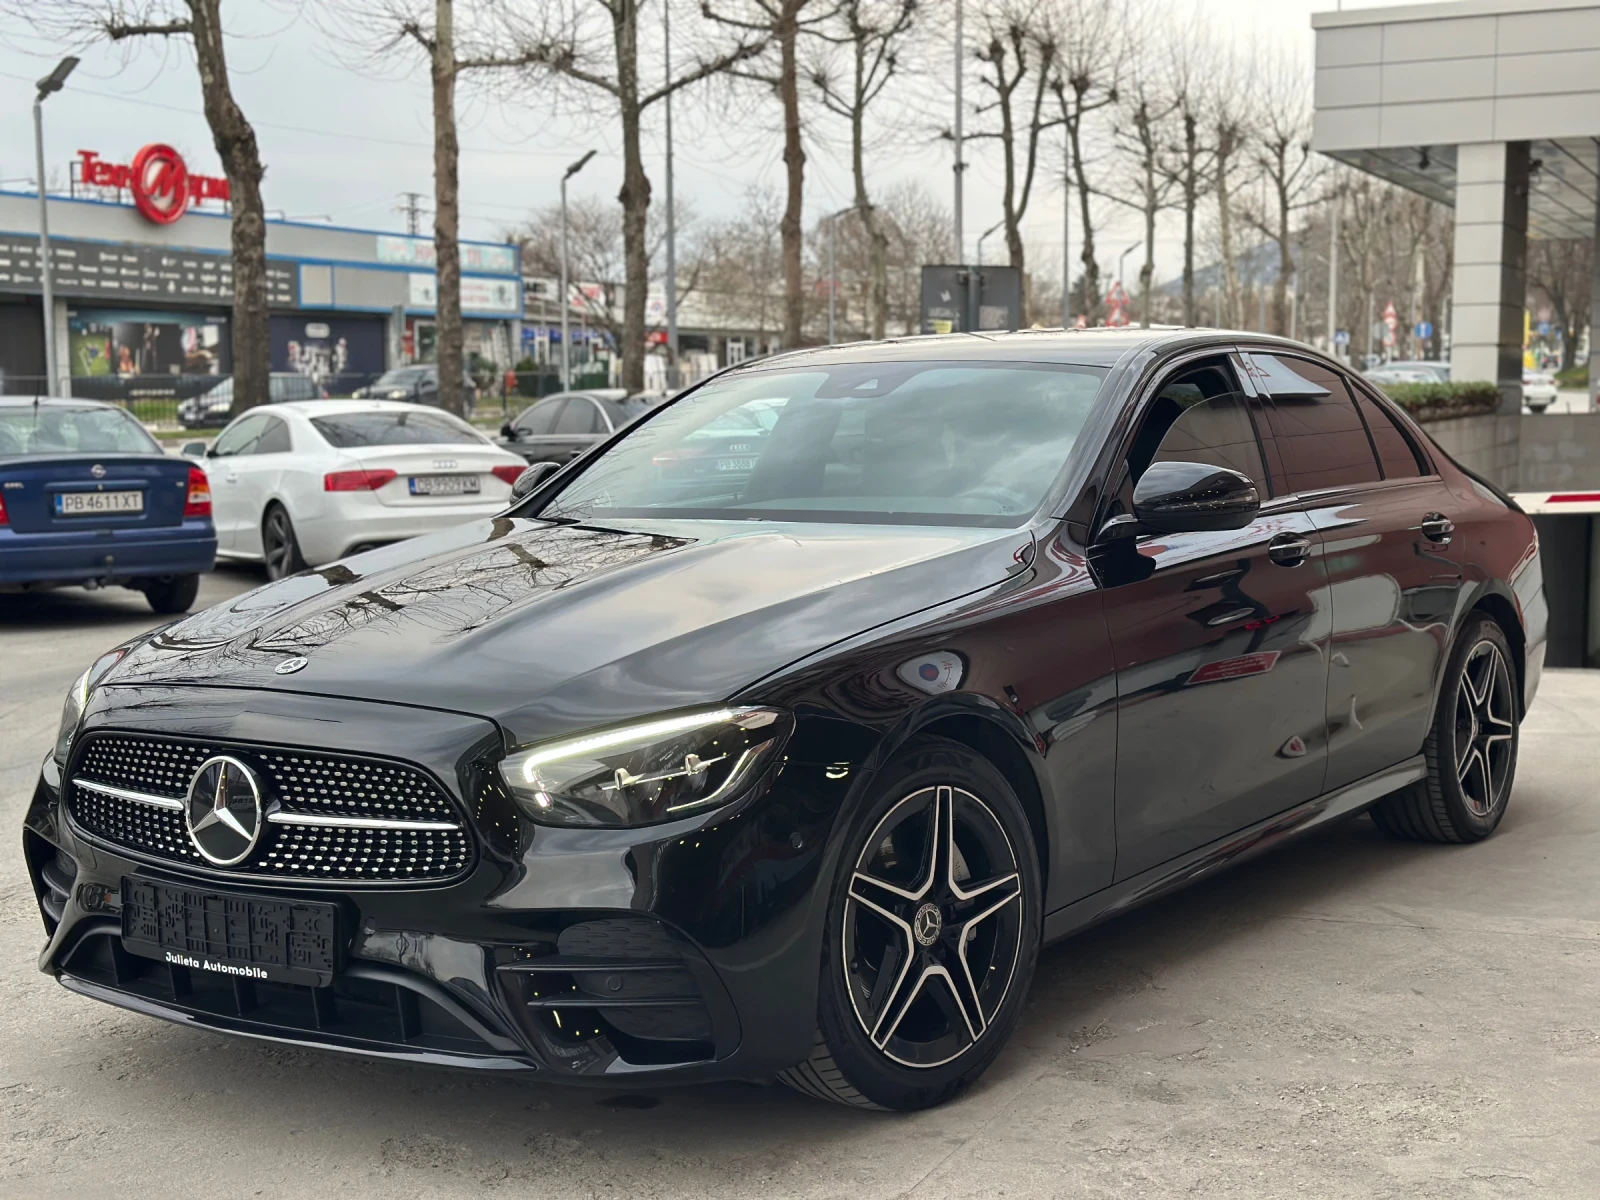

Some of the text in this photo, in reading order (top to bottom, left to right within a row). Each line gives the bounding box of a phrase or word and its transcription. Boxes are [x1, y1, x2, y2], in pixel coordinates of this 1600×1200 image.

[87, 495, 119, 509] 4611
[165, 951, 268, 979] Julieta Automobile
